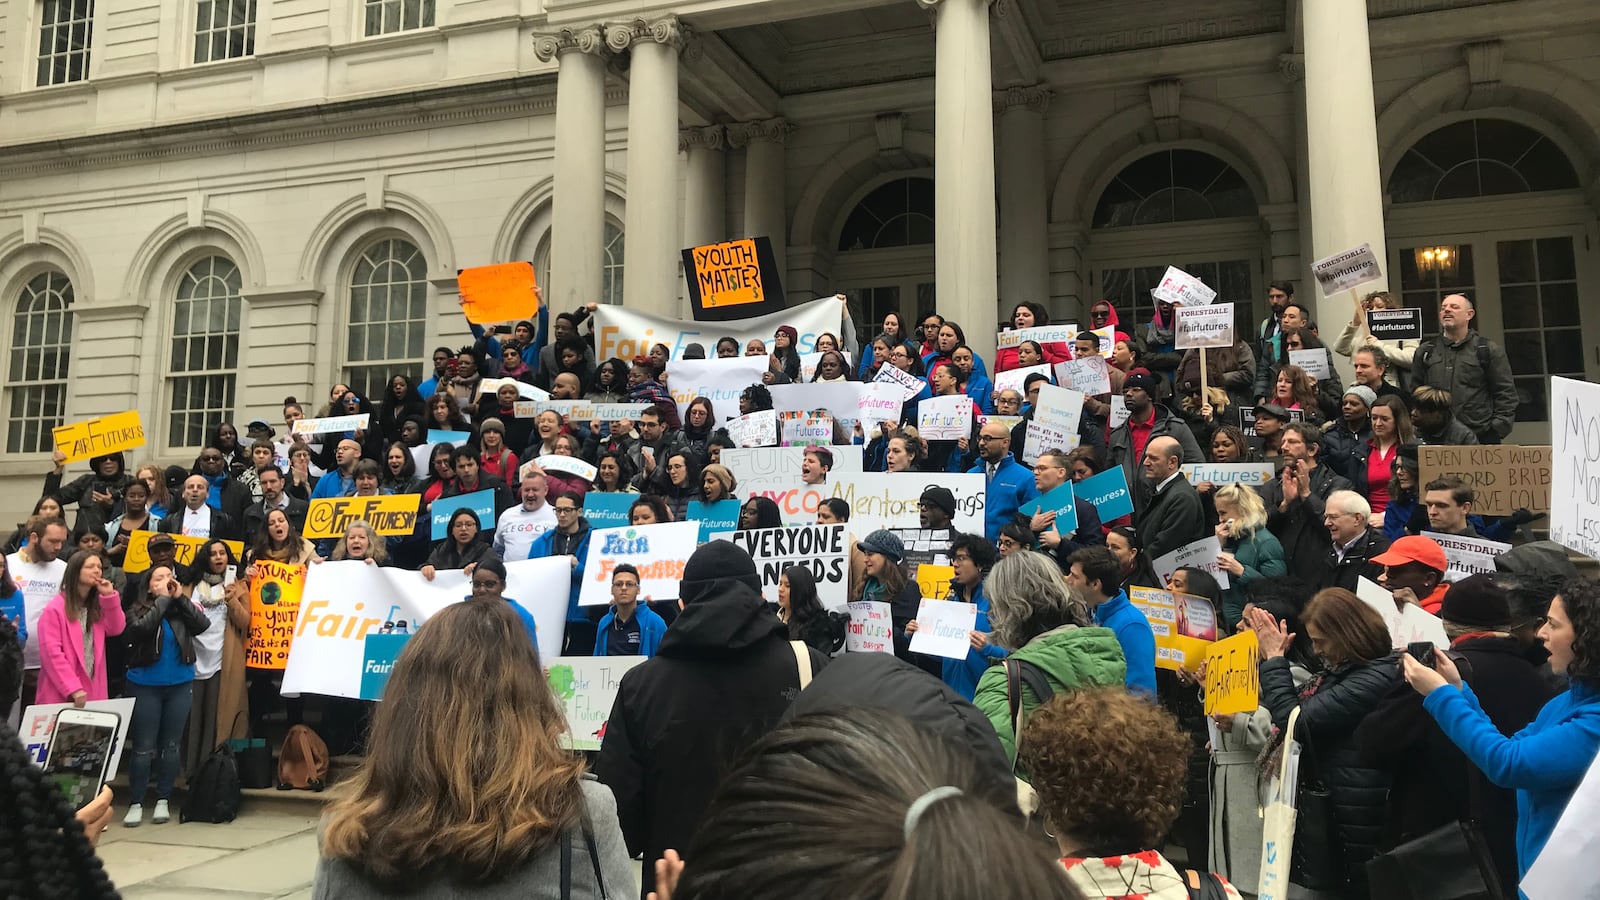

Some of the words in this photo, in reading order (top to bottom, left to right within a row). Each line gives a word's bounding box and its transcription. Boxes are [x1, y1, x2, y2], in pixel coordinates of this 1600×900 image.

[698, 245, 753, 269] YOUTH
[1317, 247, 1366, 271] FORESTDALE
[1321, 260, 1373, 282] #fairfutures
[700, 265, 761, 296] MATTER
[1181, 308, 1229, 317] FORESTDALE
[1178, 322, 1228, 333] #fairfutures
[1372, 323, 1416, 332] #fairfutures
[1001, 330, 1066, 345] FairFutures
[1425, 449, 1461, 466] EVEN
[1471, 449, 1504, 466] KIDS
[1510, 449, 1542, 464] WHO
[1508, 468, 1551, 487] BRIB
[1511, 490, 1551, 511] COLL
[763, 558, 843, 586] NDS
[272, 626, 293, 637] MA
[250, 639, 266, 648] SURE
[246, 649, 273, 665] FAIR
